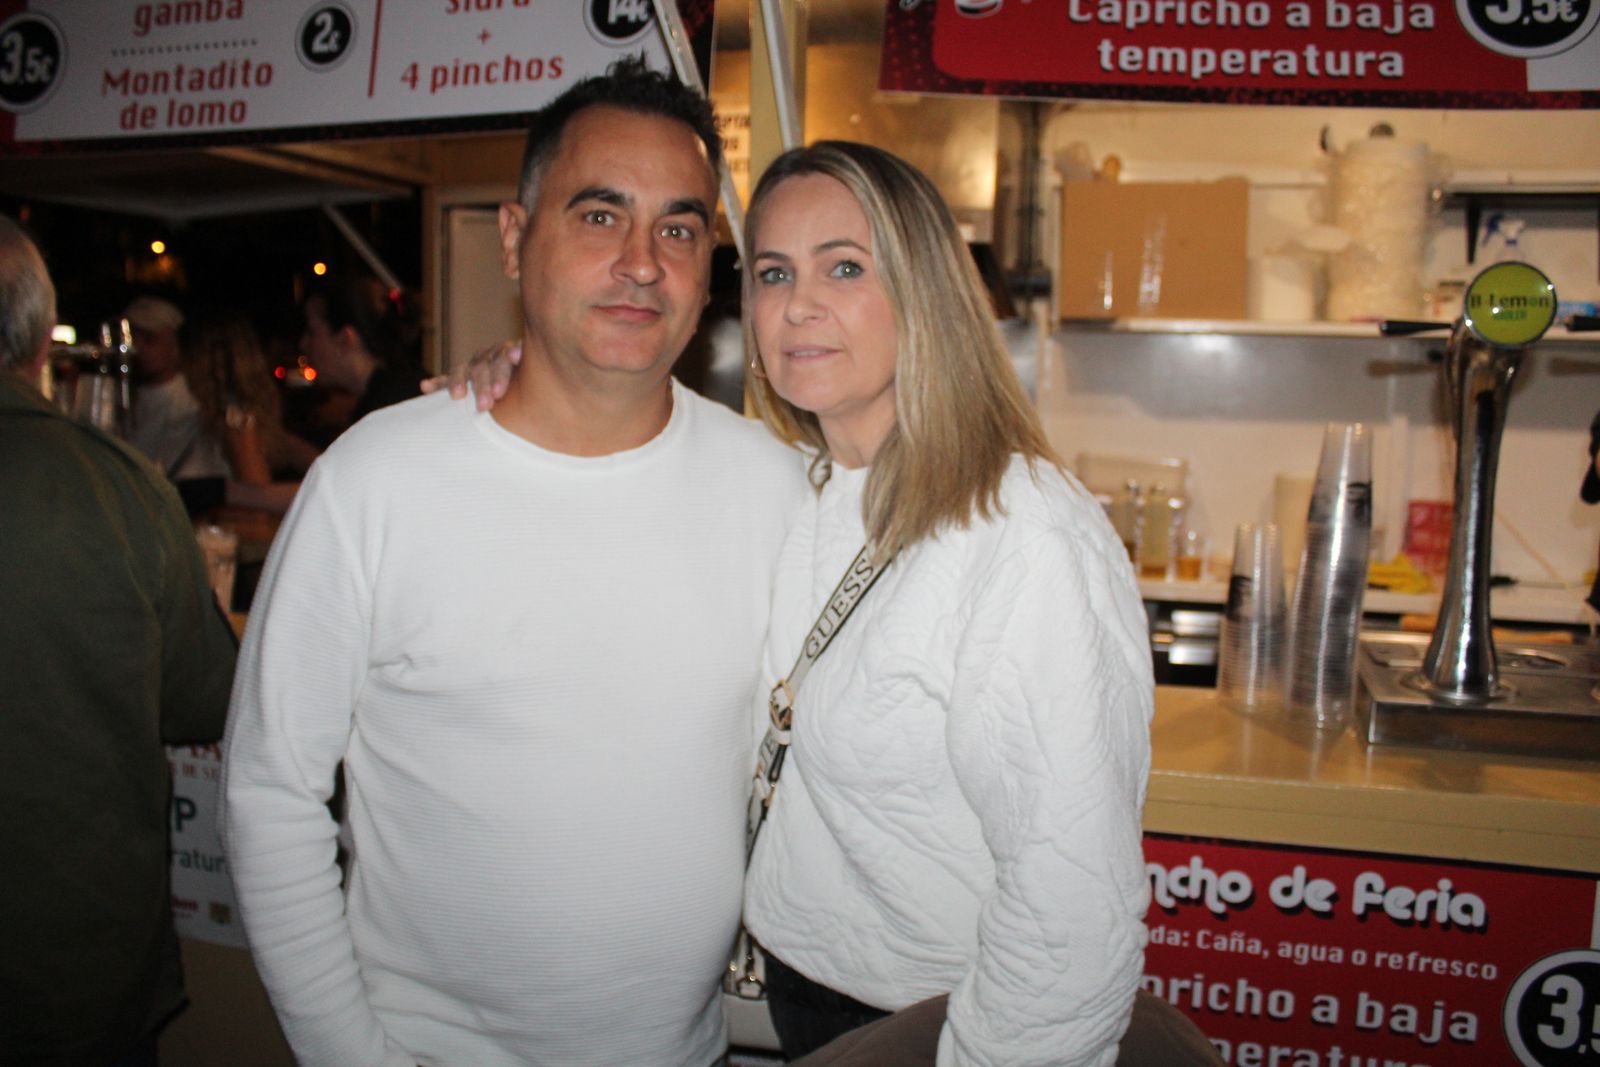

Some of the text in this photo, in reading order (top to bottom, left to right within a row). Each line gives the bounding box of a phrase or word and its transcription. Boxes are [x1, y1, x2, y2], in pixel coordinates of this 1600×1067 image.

[133, 0, 243, 36] gamba
[311, 11, 341, 54] 2€
[1068, 0, 1435, 35] Capricho a baja
[102, 59, 274, 97] Montadito
[400, 54, 564, 94] 4 pinchos
[1098, 38, 1406, 79] temperatura
[119, 98, 247, 131] de lomo
[806, 558, 875, 660] GUESS
[1269, 865, 1337, 913] de
[1196, 929, 1270, 960] Caña,
[1277, 940, 1344, 966] agua
[1351, 949, 1368, 966] o
[1375, 951, 1498, 981] refresco
[1311, 993, 1340, 1025] a
[1355, 991, 1478, 1044] baja
